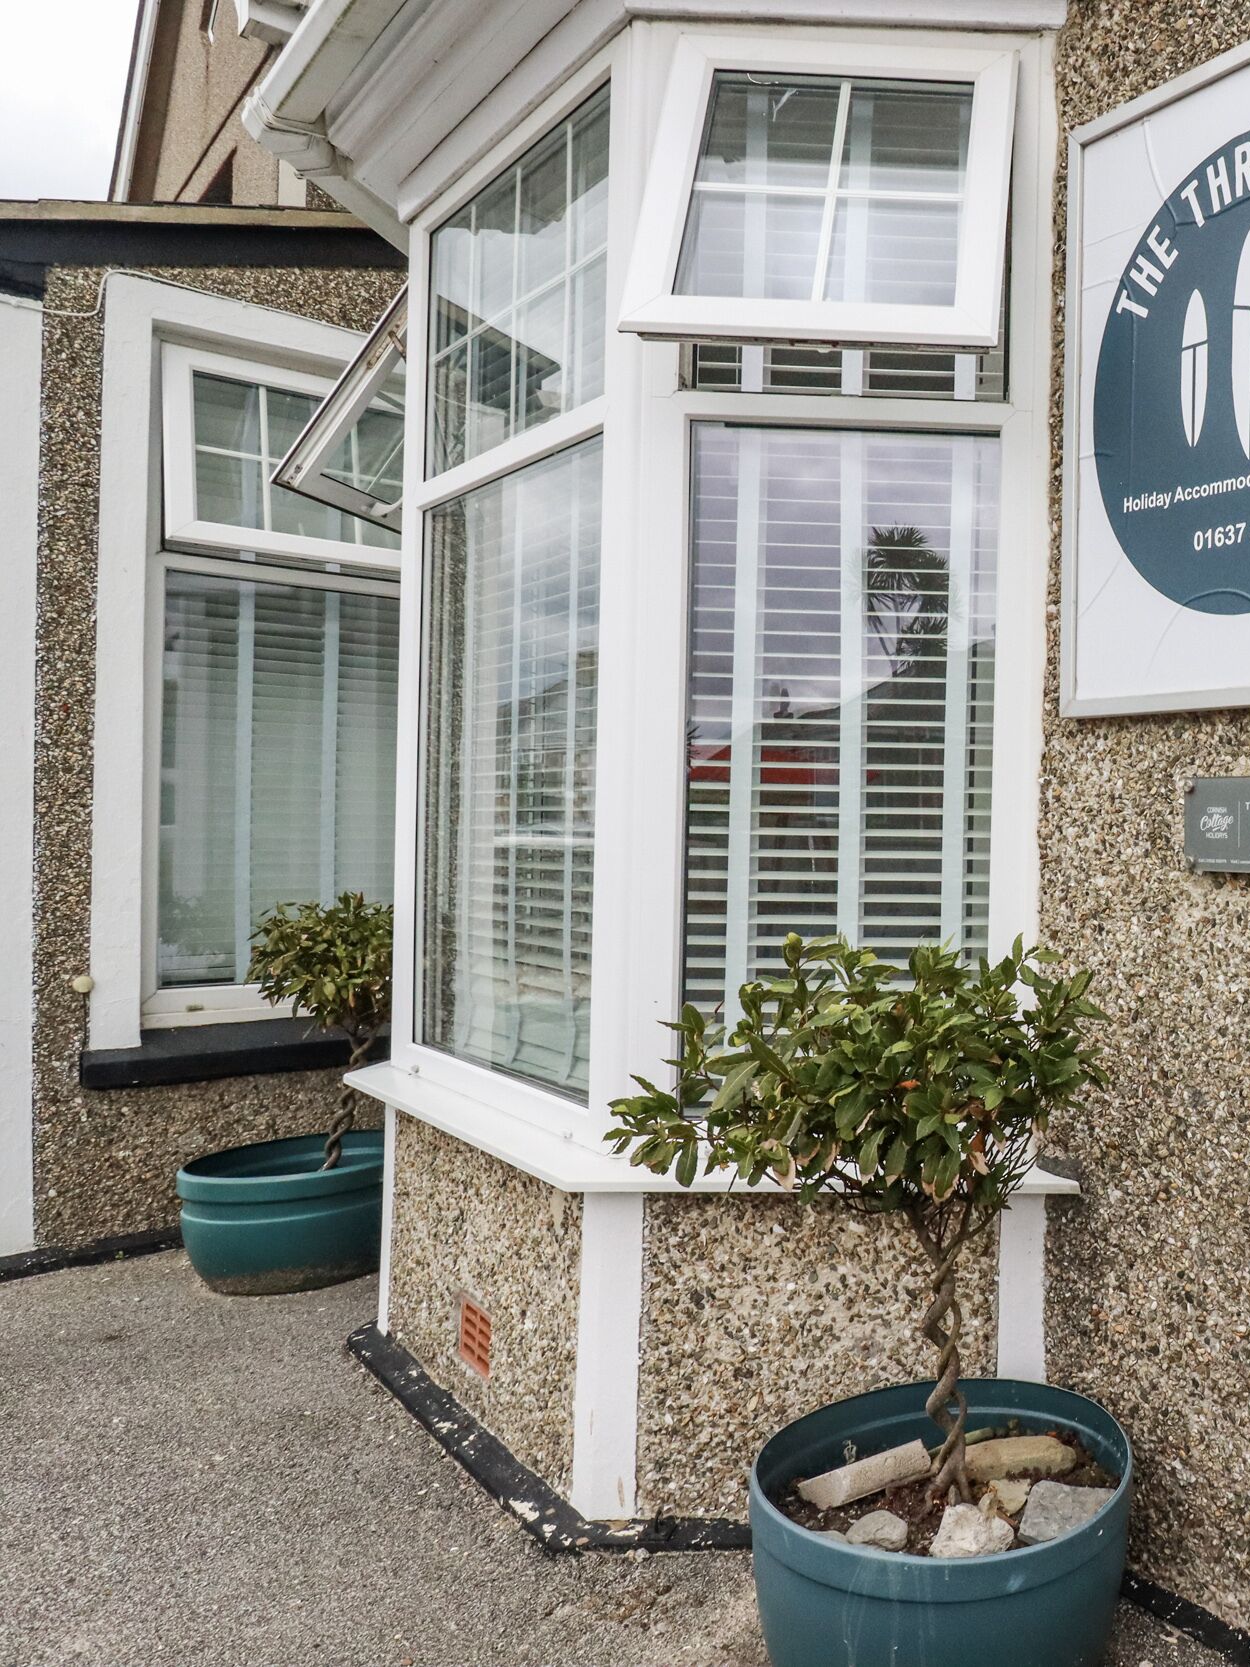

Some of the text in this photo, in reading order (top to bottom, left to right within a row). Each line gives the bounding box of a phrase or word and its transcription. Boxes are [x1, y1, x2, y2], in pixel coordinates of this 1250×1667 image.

[1116, 225, 1179, 319] THE
[1123, 490, 1172, 513] Holiday
[1193, 522, 1247, 551] 01637
[1200, 814, 1234, 832] Cottage
